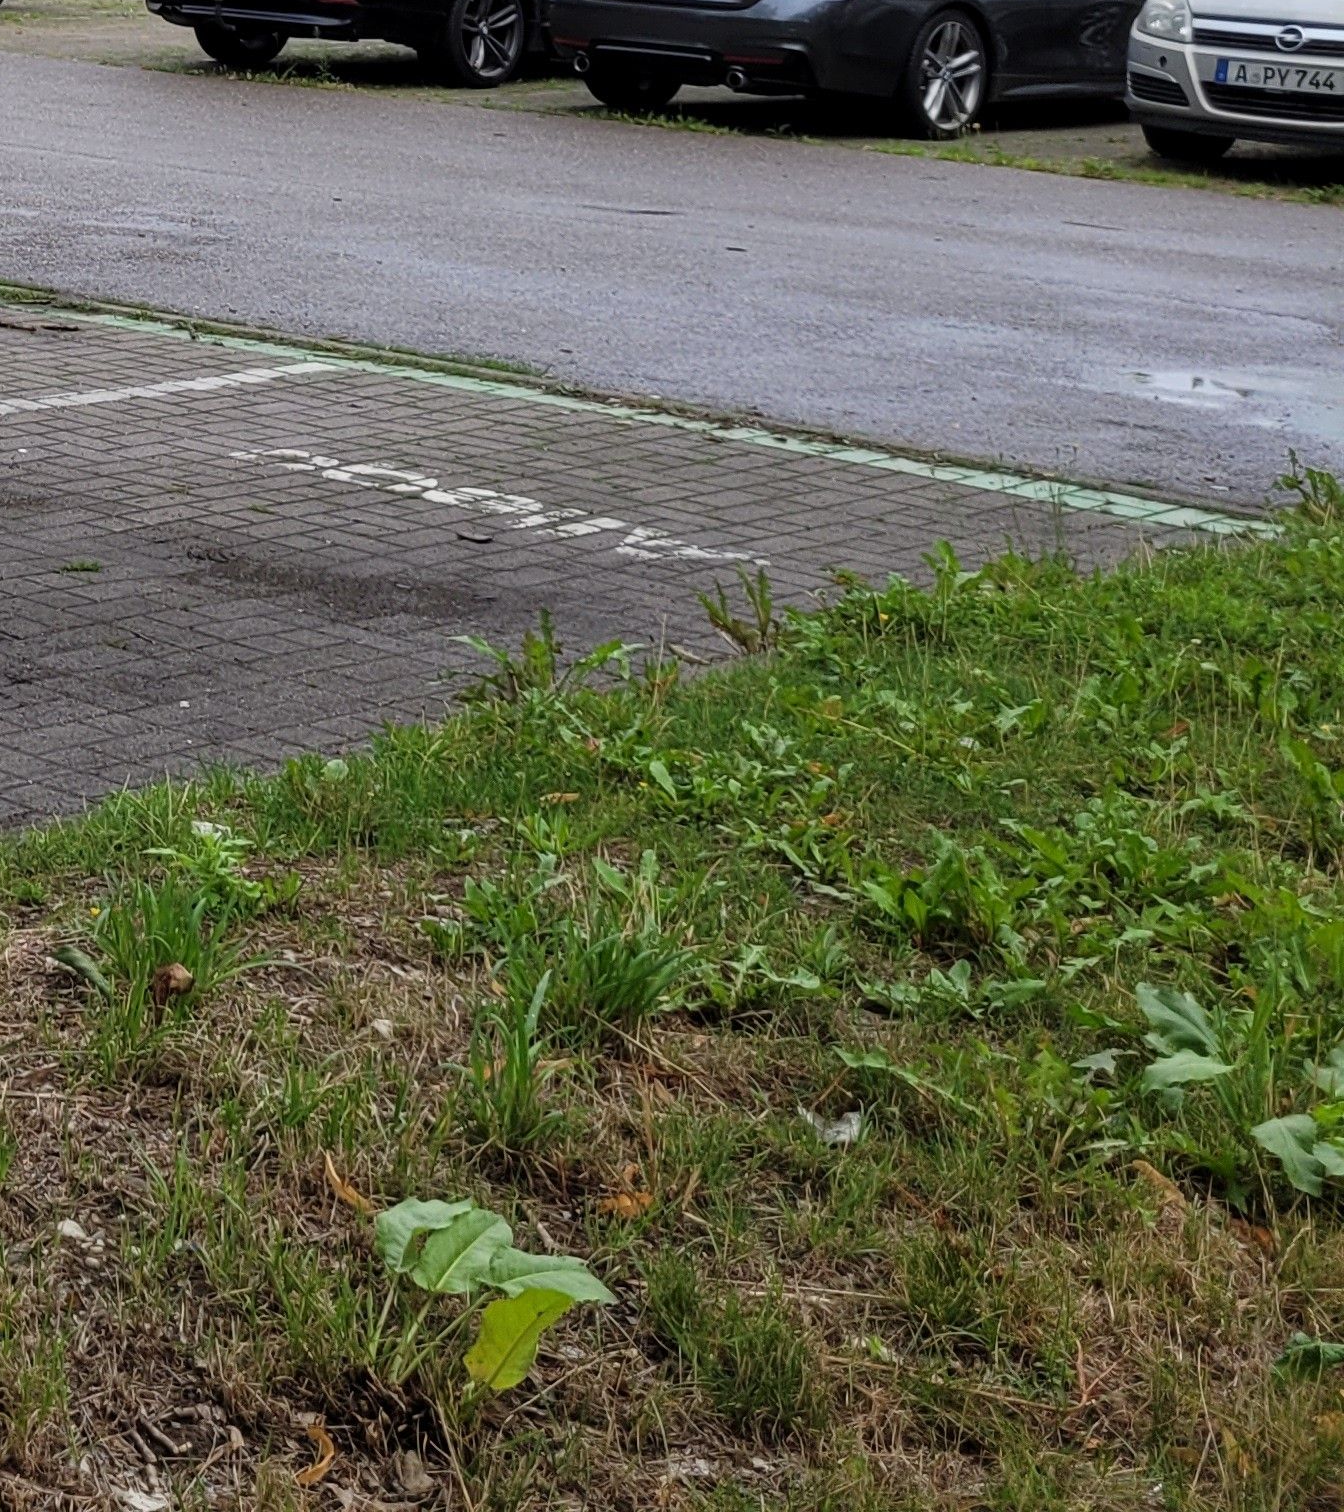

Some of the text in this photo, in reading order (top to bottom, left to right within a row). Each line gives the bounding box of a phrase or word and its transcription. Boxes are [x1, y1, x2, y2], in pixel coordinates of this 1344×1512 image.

[1235, 64, 1336, 90] A PY 744
